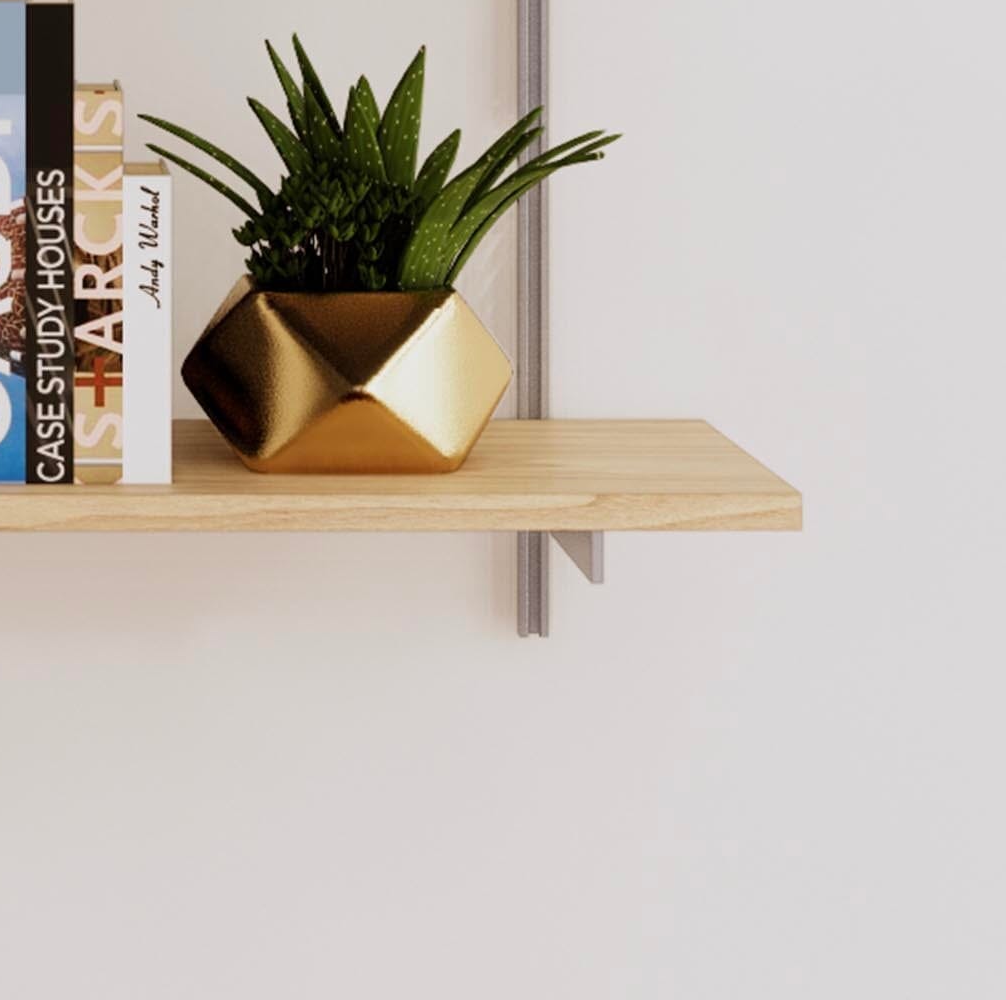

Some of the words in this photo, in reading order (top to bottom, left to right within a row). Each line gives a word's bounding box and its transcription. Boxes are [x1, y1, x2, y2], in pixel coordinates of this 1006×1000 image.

[36, 168, 66, 290] HOUSES
[138, 185, 161, 250] Warhol
[138, 258, 165, 309] Andy
[36, 297, 66, 396] STUDY
[36, 402, 66, 483] CASE
